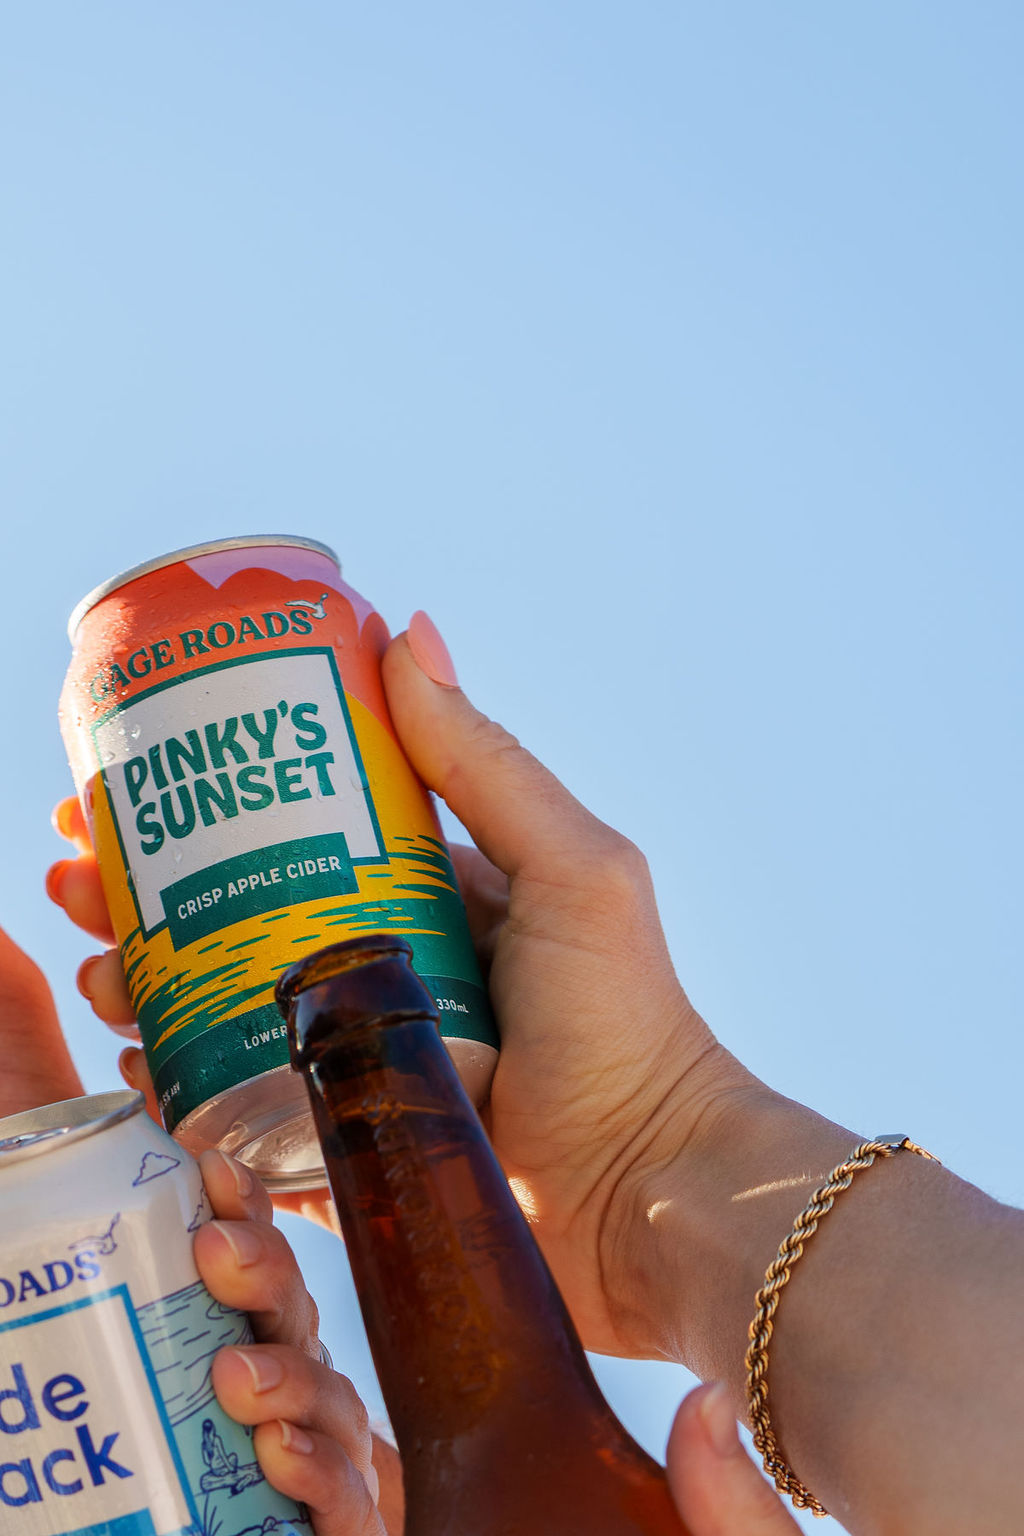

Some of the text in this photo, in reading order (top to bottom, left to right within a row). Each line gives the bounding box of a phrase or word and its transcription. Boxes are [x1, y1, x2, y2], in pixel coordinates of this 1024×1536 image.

[179, 609, 314, 660] ROADS
[123, 700, 327, 808] PINKY'S
[136, 752, 336, 856] SUNSET
[177, 855, 342, 920] CRISP APPLE CIDER
[435, 998, 469, 1013] 330mL
[244, 1025, 288, 1050] LOWER
